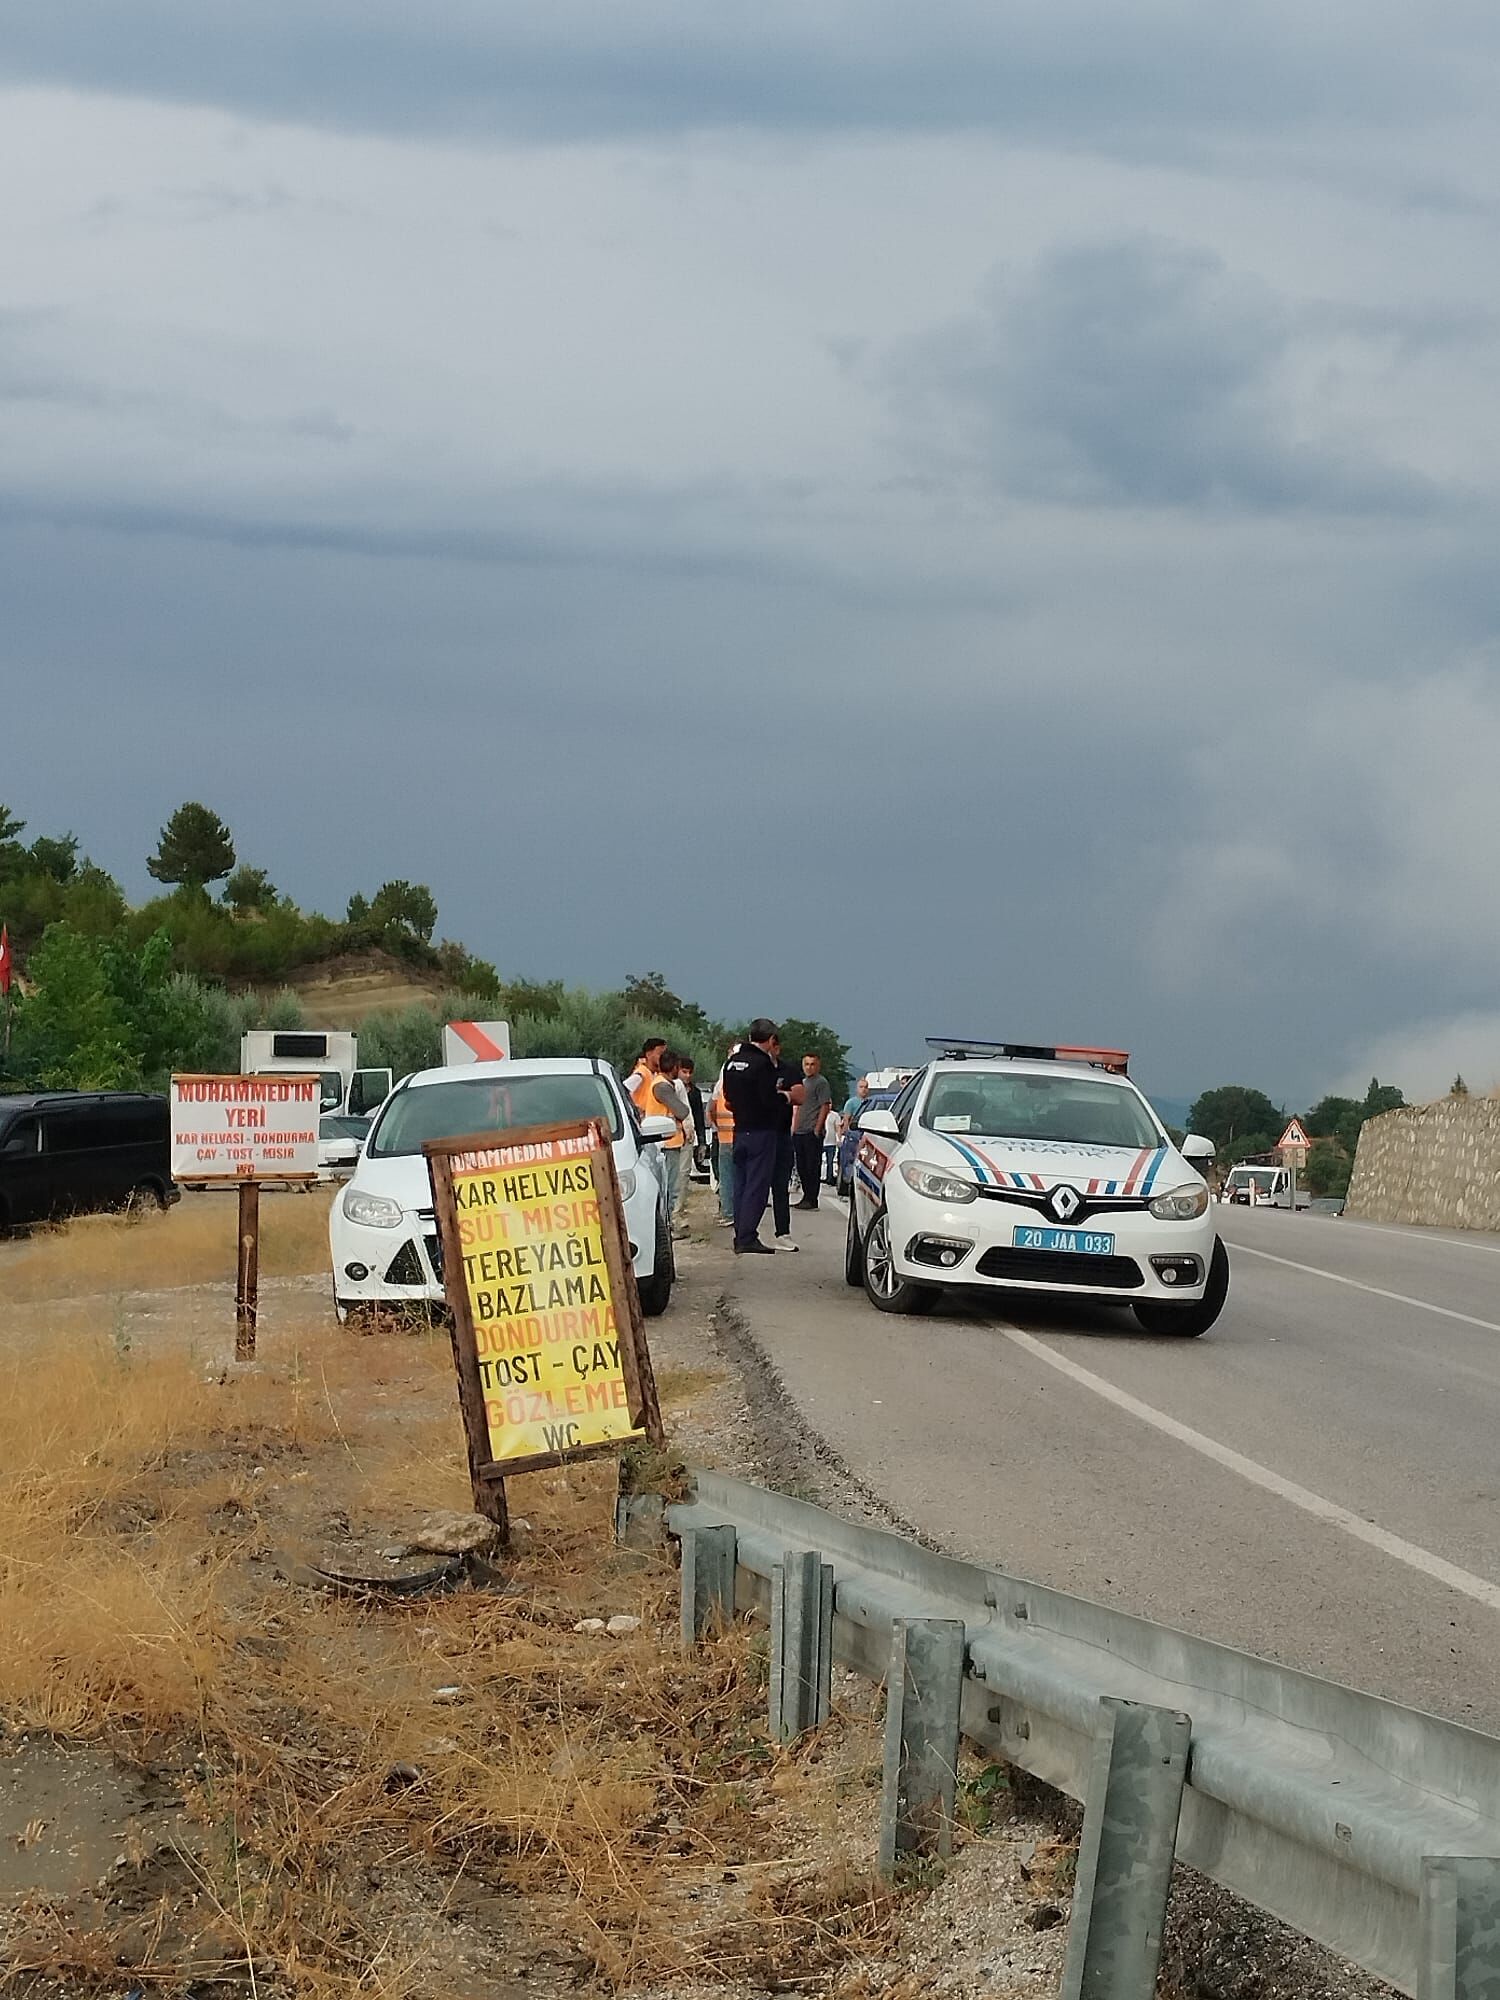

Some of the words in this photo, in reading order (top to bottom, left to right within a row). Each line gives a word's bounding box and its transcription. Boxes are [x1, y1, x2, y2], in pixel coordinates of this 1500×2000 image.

[225, 1106, 266, 1127] YERİ
[175, 1133, 198, 1145] KAR
[201, 1133, 244, 1145] HELVASI
[253, 1132, 315, 1144] DONDURMA
[197, 1149, 217, 1162] ÇAY
[227, 1148, 253, 1160] TOST
[262, 1148, 295, 1160] MISIR
[452, 1180, 497, 1210] KAR
[459, 1208, 510, 1245] SÜT
[522, 1201, 600, 1235] MISIR
[462, 1232, 608, 1284] TEREYAĞL
[1024, 1231, 1042, 1247] 20
[1051, 1233, 1076, 1250] JAA
[1085, 1235, 1111, 1253] 033
[476, 1274, 606, 1321] BAZLAMA
[474, 1305, 617, 1356] DONDURMA
[478, 1352, 542, 1389] TOST
[572, 1340, 621, 1380] ÇAY
[485, 1378, 628, 1429] GÖZLEME
[542, 1422, 582, 1450] WC
